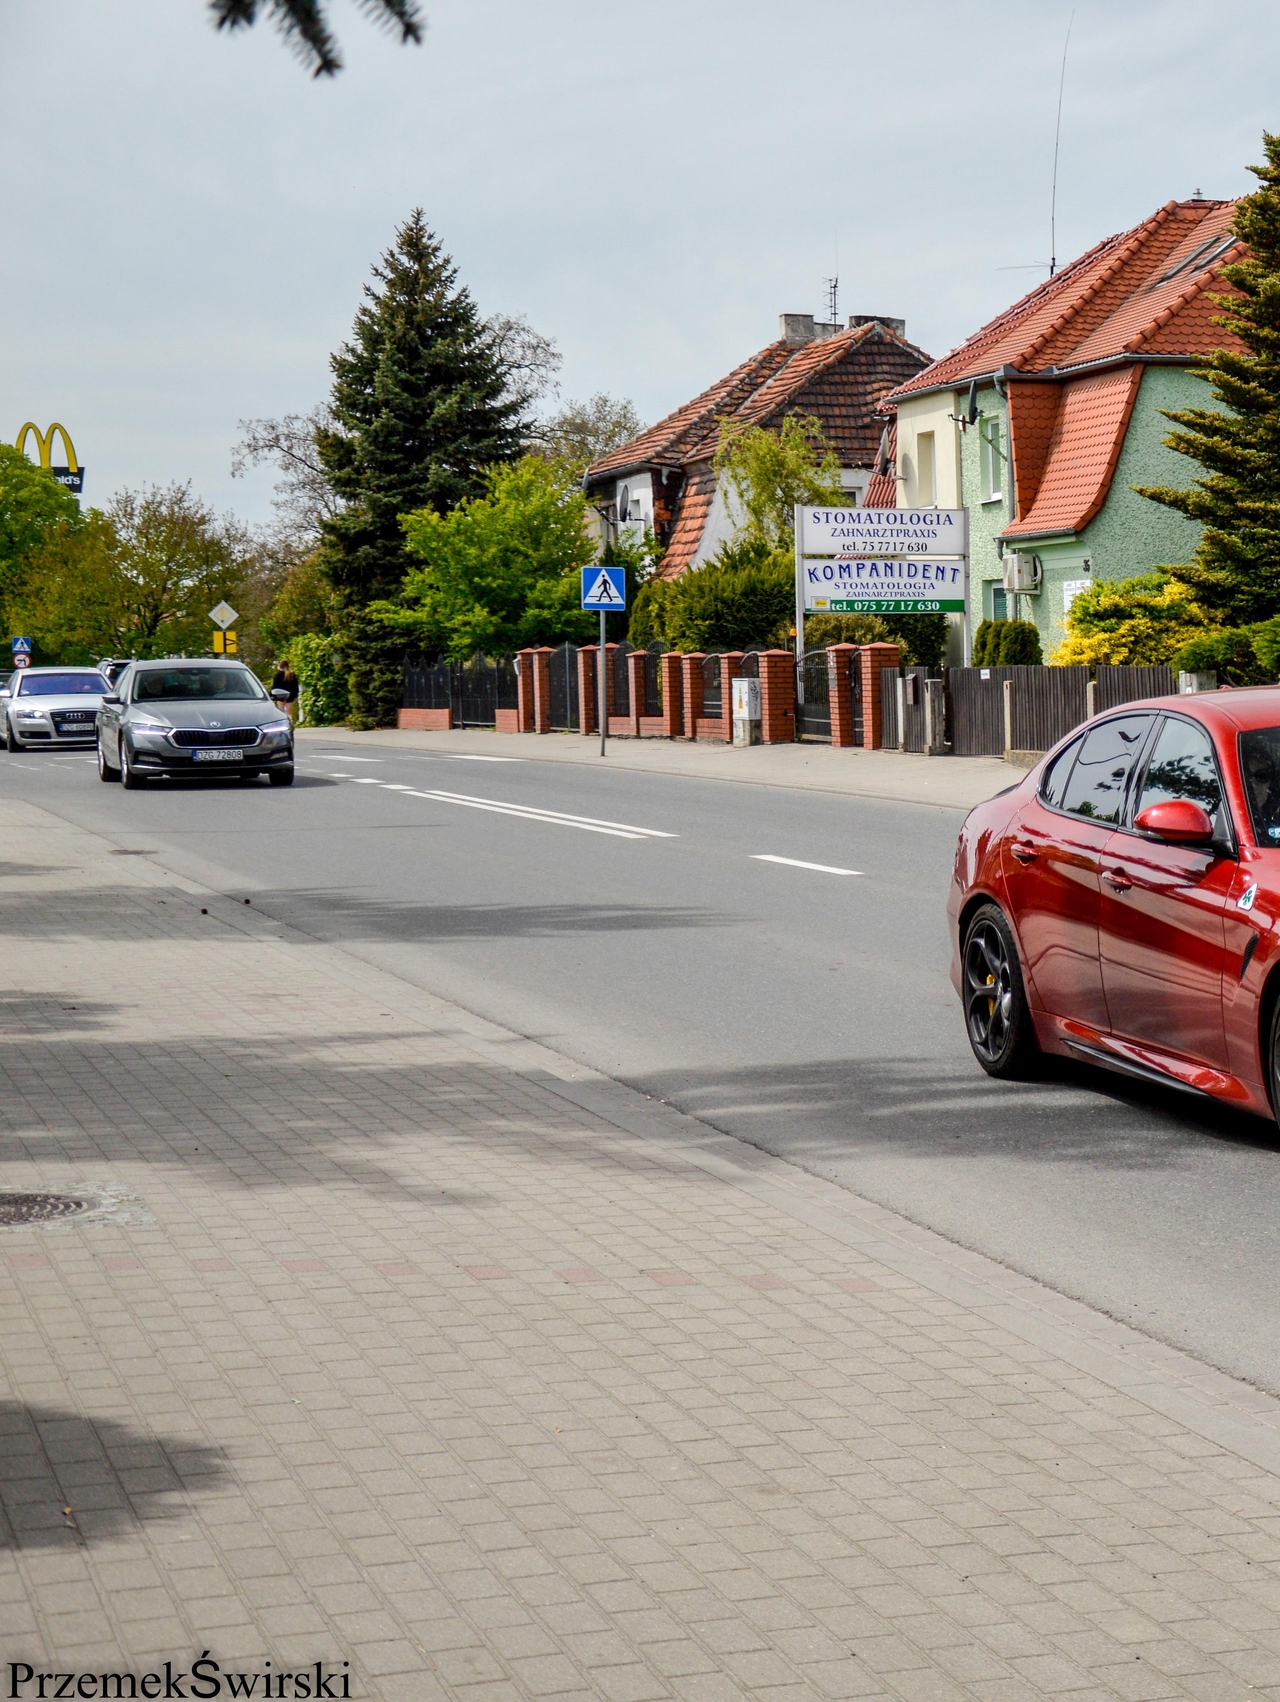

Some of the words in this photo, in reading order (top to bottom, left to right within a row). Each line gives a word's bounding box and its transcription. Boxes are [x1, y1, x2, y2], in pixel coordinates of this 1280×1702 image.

[812, 511, 954, 526] STOMATOLOGIA
[830, 527, 938, 538] ZAHNARZTPRAXIS
[842, 541, 859, 551] tel.
[862, 541, 875, 552] 75
[907, 542, 928, 552] 630
[807, 562, 961, 584] KOMPANIDENT
[834, 582, 936, 590] STOMATOLOGIA
[831, 601, 851, 611] tel.
[854, 601, 877, 611] 075
[881, 601, 895, 611] 77
[900, 601, 914, 611] 17
[917, 601, 940, 611] 630
[197, 751, 214, 760] DZG
[216, 750, 242, 759] 72808
